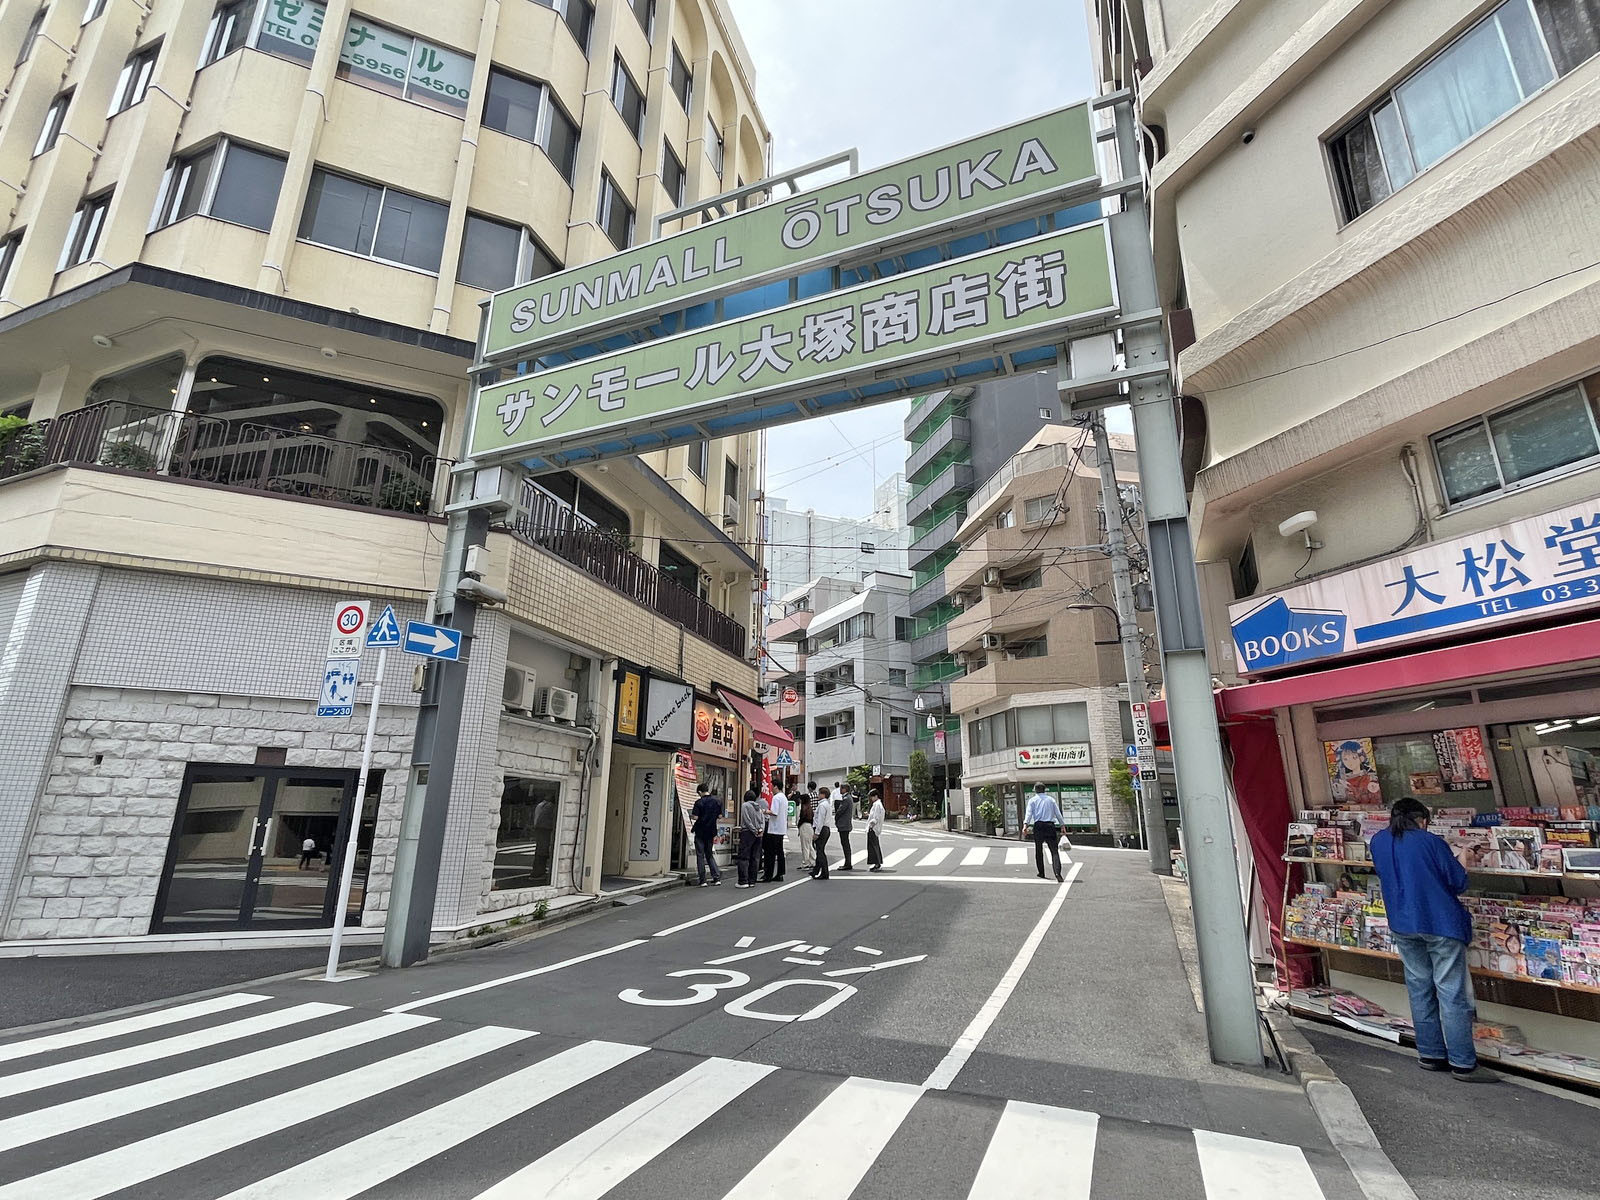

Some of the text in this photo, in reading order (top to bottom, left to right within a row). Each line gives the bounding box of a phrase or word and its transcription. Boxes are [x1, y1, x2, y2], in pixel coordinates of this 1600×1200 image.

[266, 20, 295, 41] TEL
[511, 138, 1058, 334] SUNMALL ŌTSUKA
[496, 249, 1068, 437] サンモール大塚商店街
[1385, 512, 1600, 616] 大松堂
[342, 613, 358, 627] 30
[1477, 597, 1518, 616] TEL
[1244, 621, 1340, 661] BOOKS
[647, 687, 692, 738] Welcome back
[1136, 719, 1148, 745] さのや
[639, 772, 655, 857] Welcome back
[703, 936, 929, 977] ゾーン
[618, 968, 859, 1023] 30
